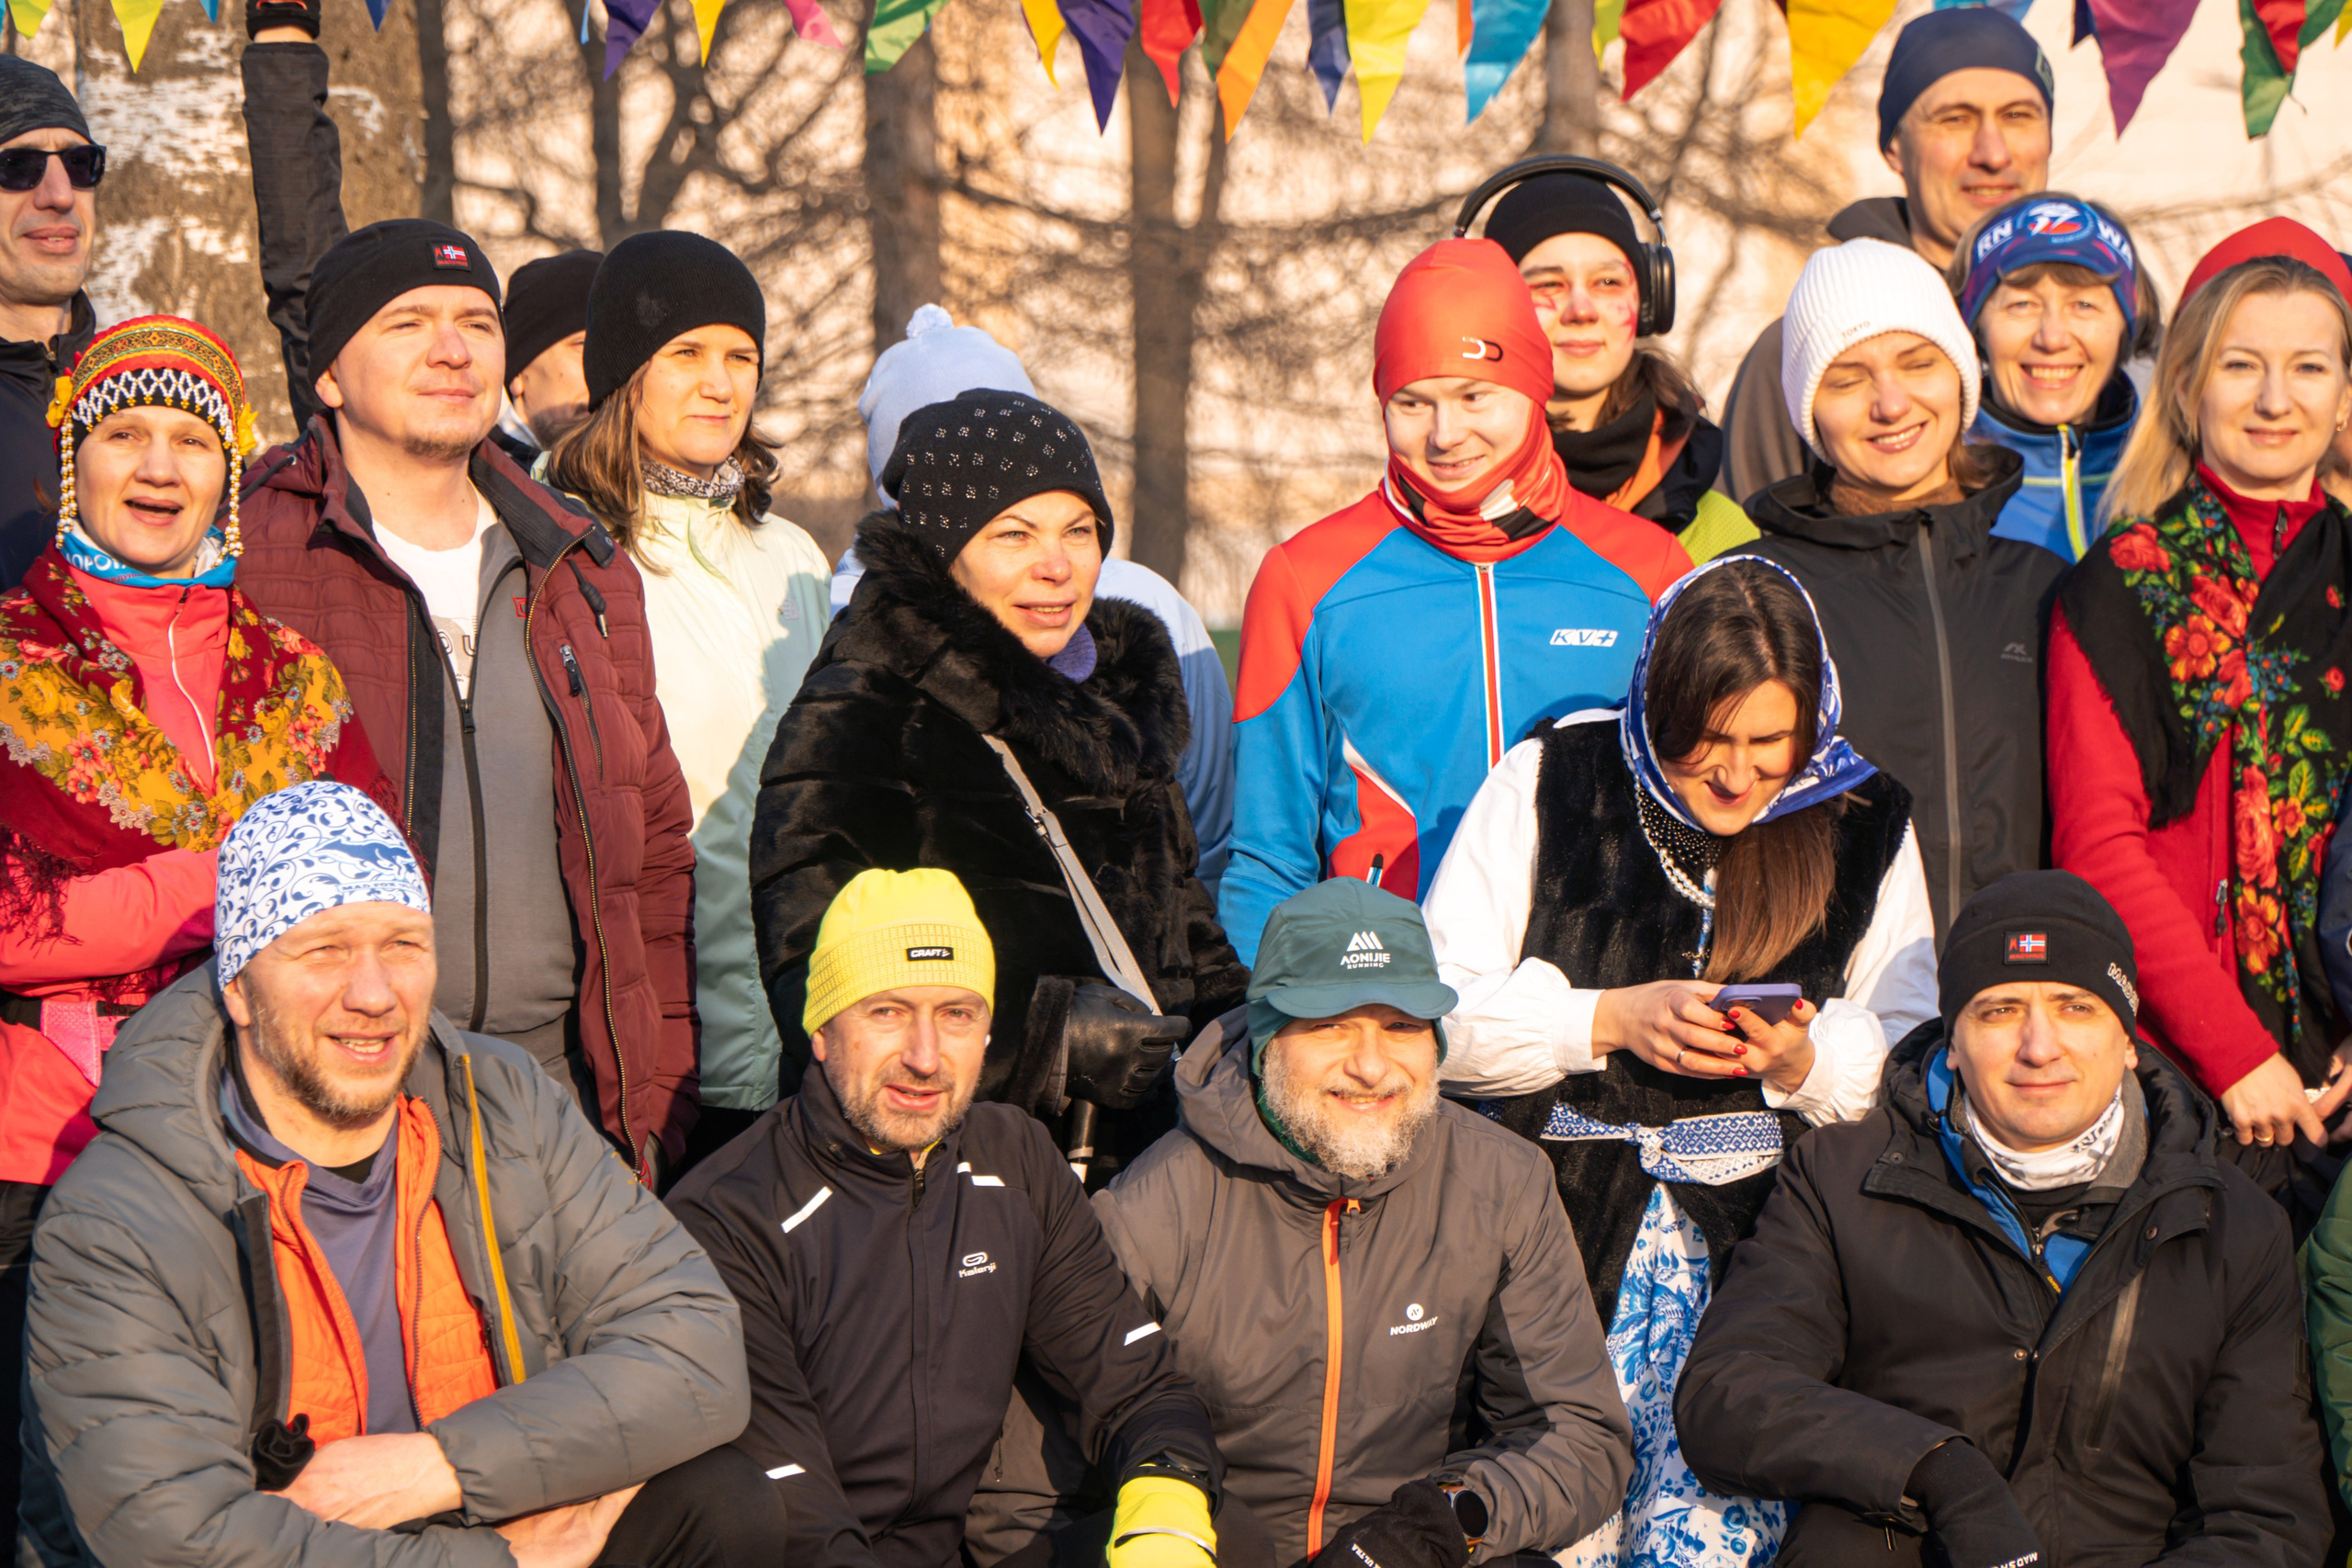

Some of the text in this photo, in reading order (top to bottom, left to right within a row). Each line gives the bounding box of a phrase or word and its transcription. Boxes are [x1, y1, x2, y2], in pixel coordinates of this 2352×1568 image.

[1841, 321, 1871, 339] TOKYO
[1552, 629, 1617, 646] KV+
[910, 948, 943, 958] CRAFT
[1340, 952, 1391, 966] AONIJIE
[1347, 962, 1385, 970] RUNNING
[958, 1261, 997, 1278] Kalenji
[1390, 1315, 1439, 1337] NORDWAY
